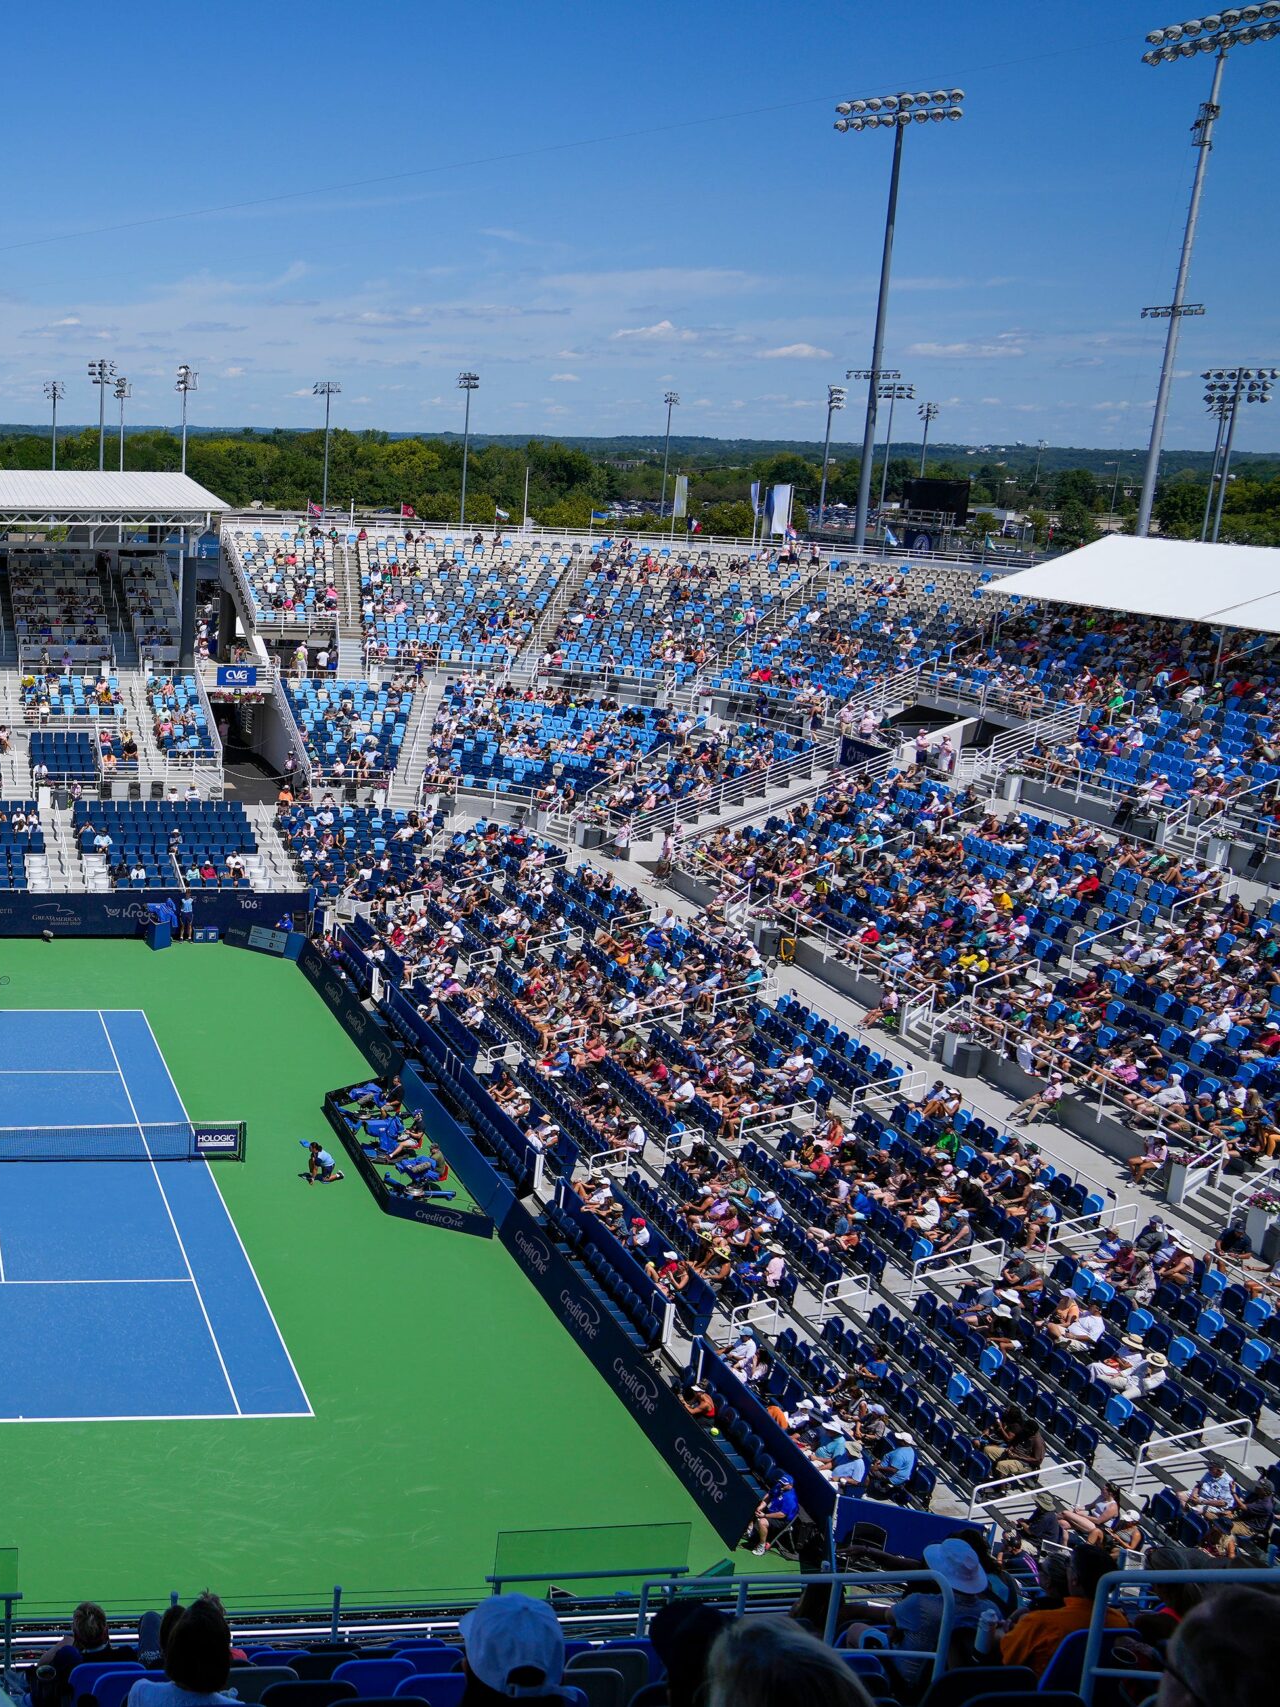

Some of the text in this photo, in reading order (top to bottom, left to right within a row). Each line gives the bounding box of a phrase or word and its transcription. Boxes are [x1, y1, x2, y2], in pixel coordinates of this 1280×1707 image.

[225, 670, 249, 680] CVG
[122, 903, 158, 924] Krog
[240, 900, 258, 909] 106
[197, 1134, 235, 1142] HOLOGIC
[415, 1209, 464, 1228] CreditOne
[514, 1230, 547, 1275] CreditOne
[560, 1289, 597, 1340] CreditOne
[613, 1357, 656, 1415] CreditOne
[674, 1436, 724, 1504] CreditOne
